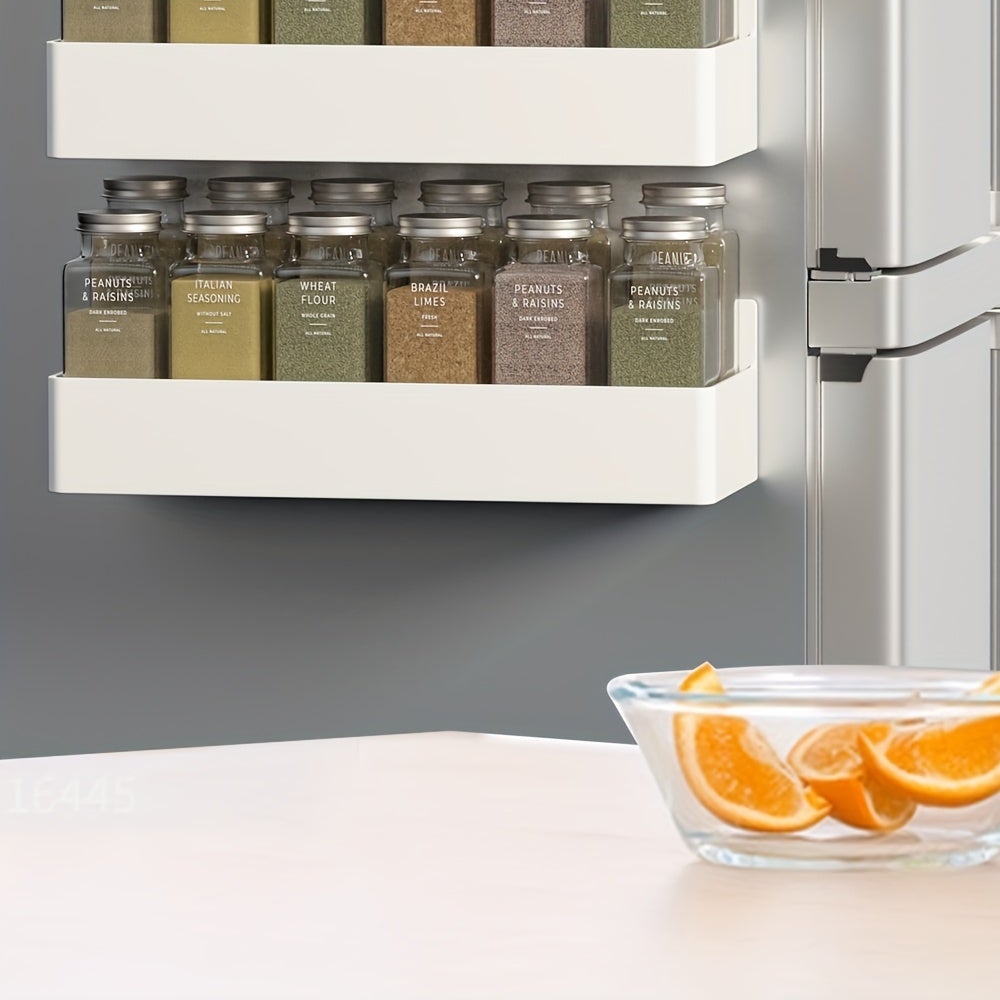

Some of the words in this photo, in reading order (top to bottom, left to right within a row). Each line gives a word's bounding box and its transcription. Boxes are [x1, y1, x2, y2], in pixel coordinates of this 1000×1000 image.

[84, 278, 132, 288] PEANUTS
[194, 280, 232, 290] ITALIAN
[300, 281, 336, 291] WHEAT
[411, 282, 448, 293] BRAZIL
[514, 284, 563, 294] PEANUTS
[630, 285, 679, 296] PEANUTS
[82, 292, 88, 302] &
[92, 292, 134, 302] RAISINS
[187, 293, 241, 304] SEASONING
[301, 295, 336, 305] FLOUR
[414, 297, 446, 307] LIMES
[512, 298, 518, 309] &
[522, 298, 565, 309] RAISINS
[628, 300, 634, 310] &
[639, 300, 681, 310] RAISINS
